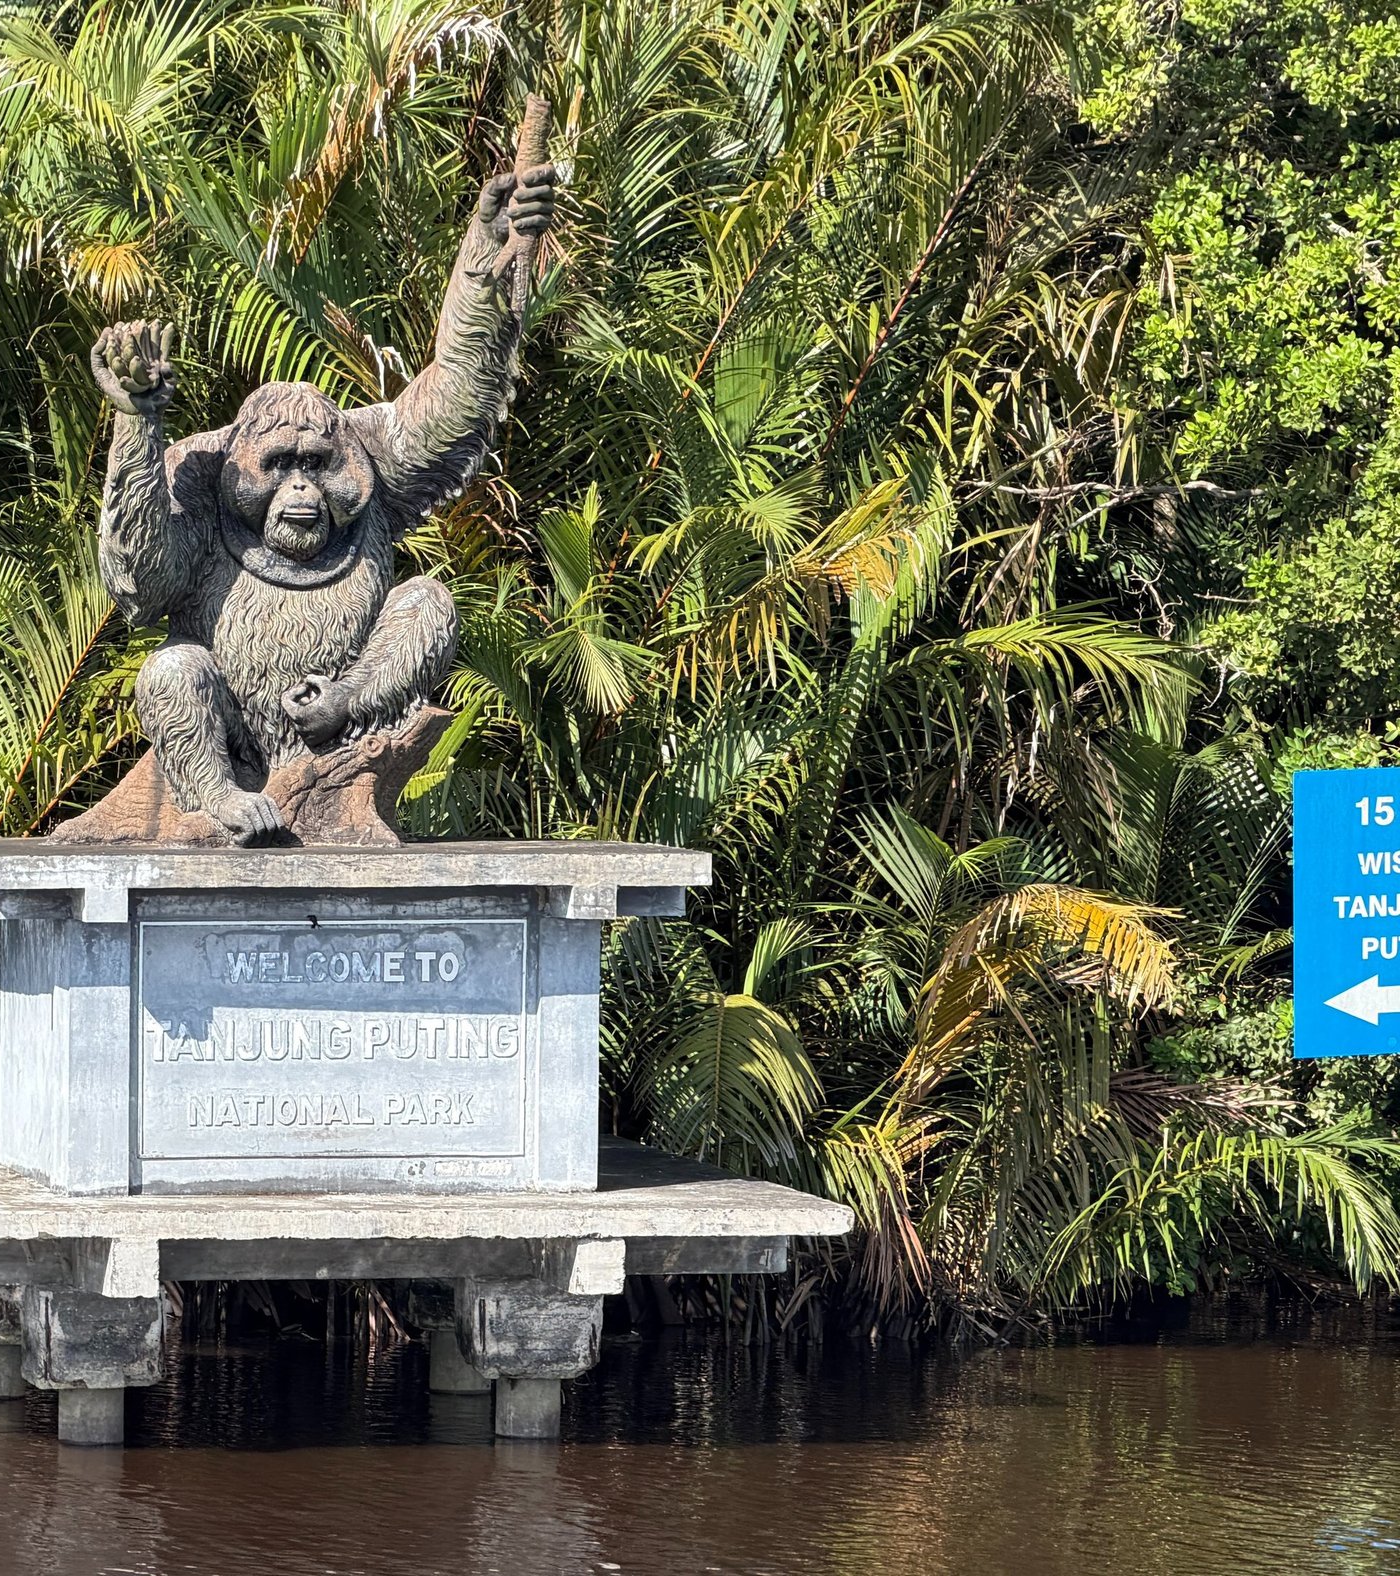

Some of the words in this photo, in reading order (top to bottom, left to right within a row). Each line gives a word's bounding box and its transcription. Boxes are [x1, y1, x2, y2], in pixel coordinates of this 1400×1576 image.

[1355, 796, 1395, 826] 15
[1361, 936, 1400, 960] PU
[226, 951, 405, 984] WELCOME
[415, 951, 460, 983] TO
[146, 1018, 352, 1062] TANJUNG
[363, 1017, 521, 1060] PUTING
[187, 1093, 375, 1127] NATIONAL
[383, 1092, 475, 1126] PARK
